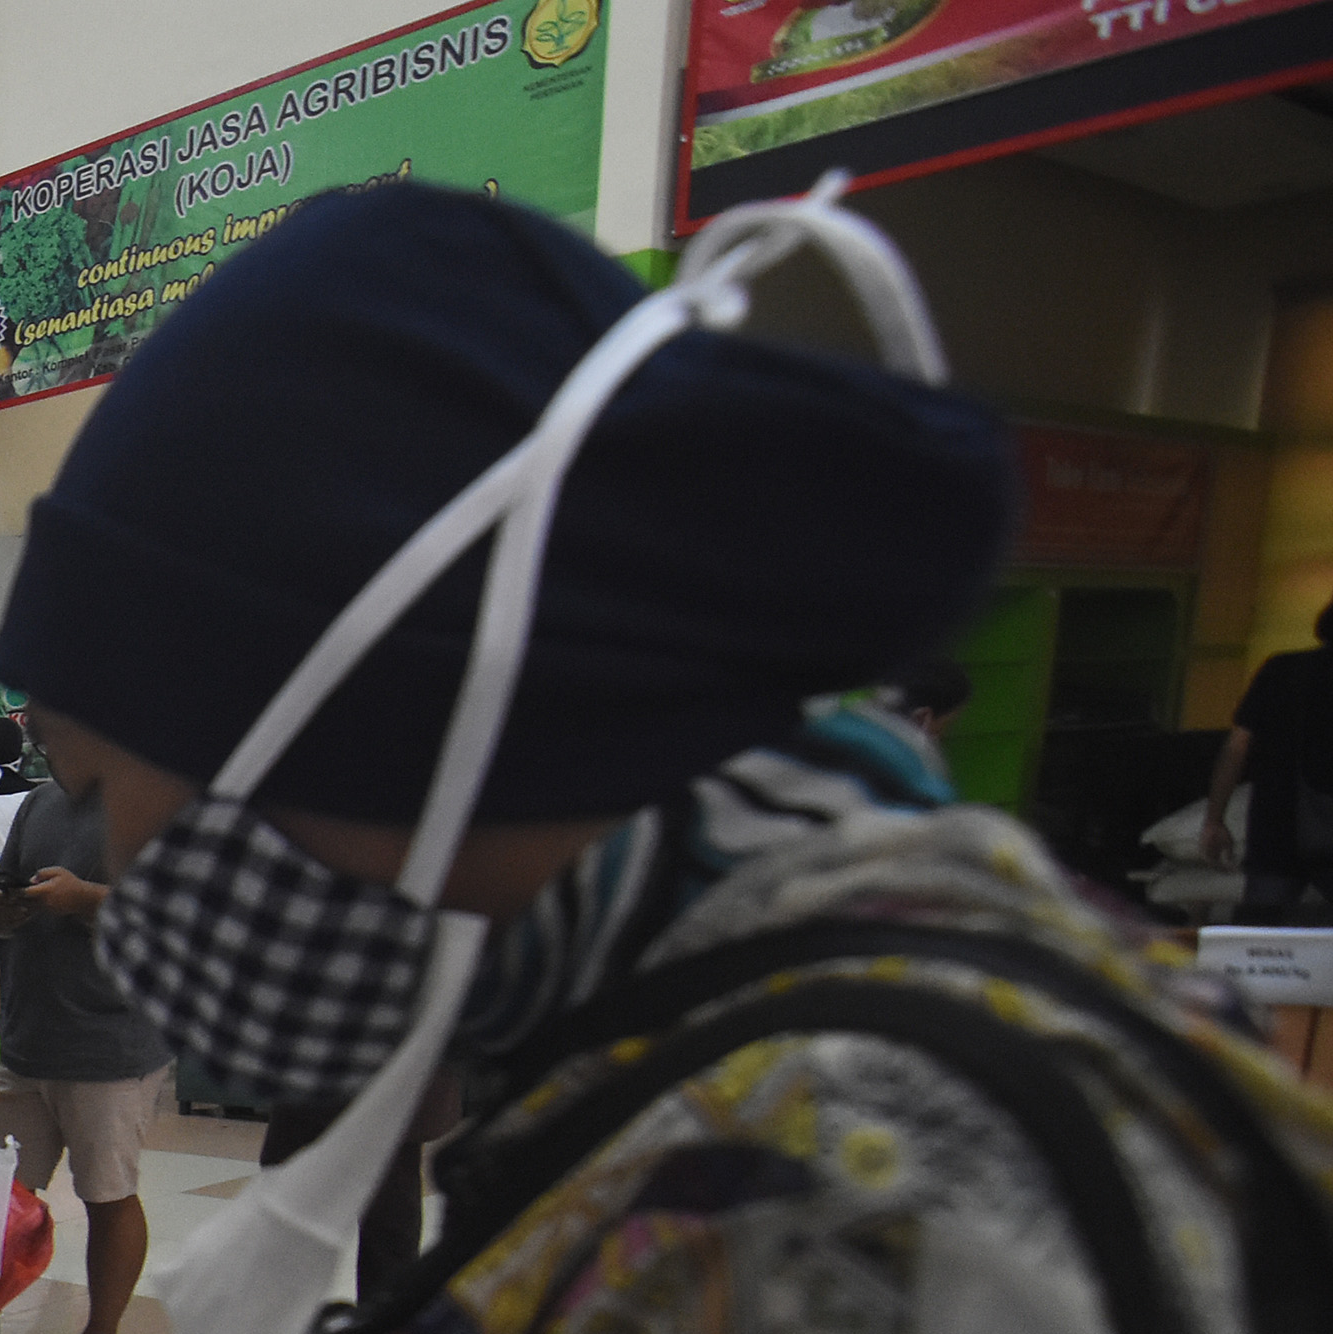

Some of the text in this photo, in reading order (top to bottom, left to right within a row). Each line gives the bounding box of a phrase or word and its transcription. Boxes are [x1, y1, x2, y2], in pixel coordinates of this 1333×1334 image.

[12, 137, 171, 222] KOPERASI
[175, 103, 268, 165] JASA
[275, 16, 512, 131] AGRIBISNIS
[174, 142, 294, 218] (KOJA)
[77, 228, 217, 289] continuous
[14, 289, 155, 347] (senantiasa
